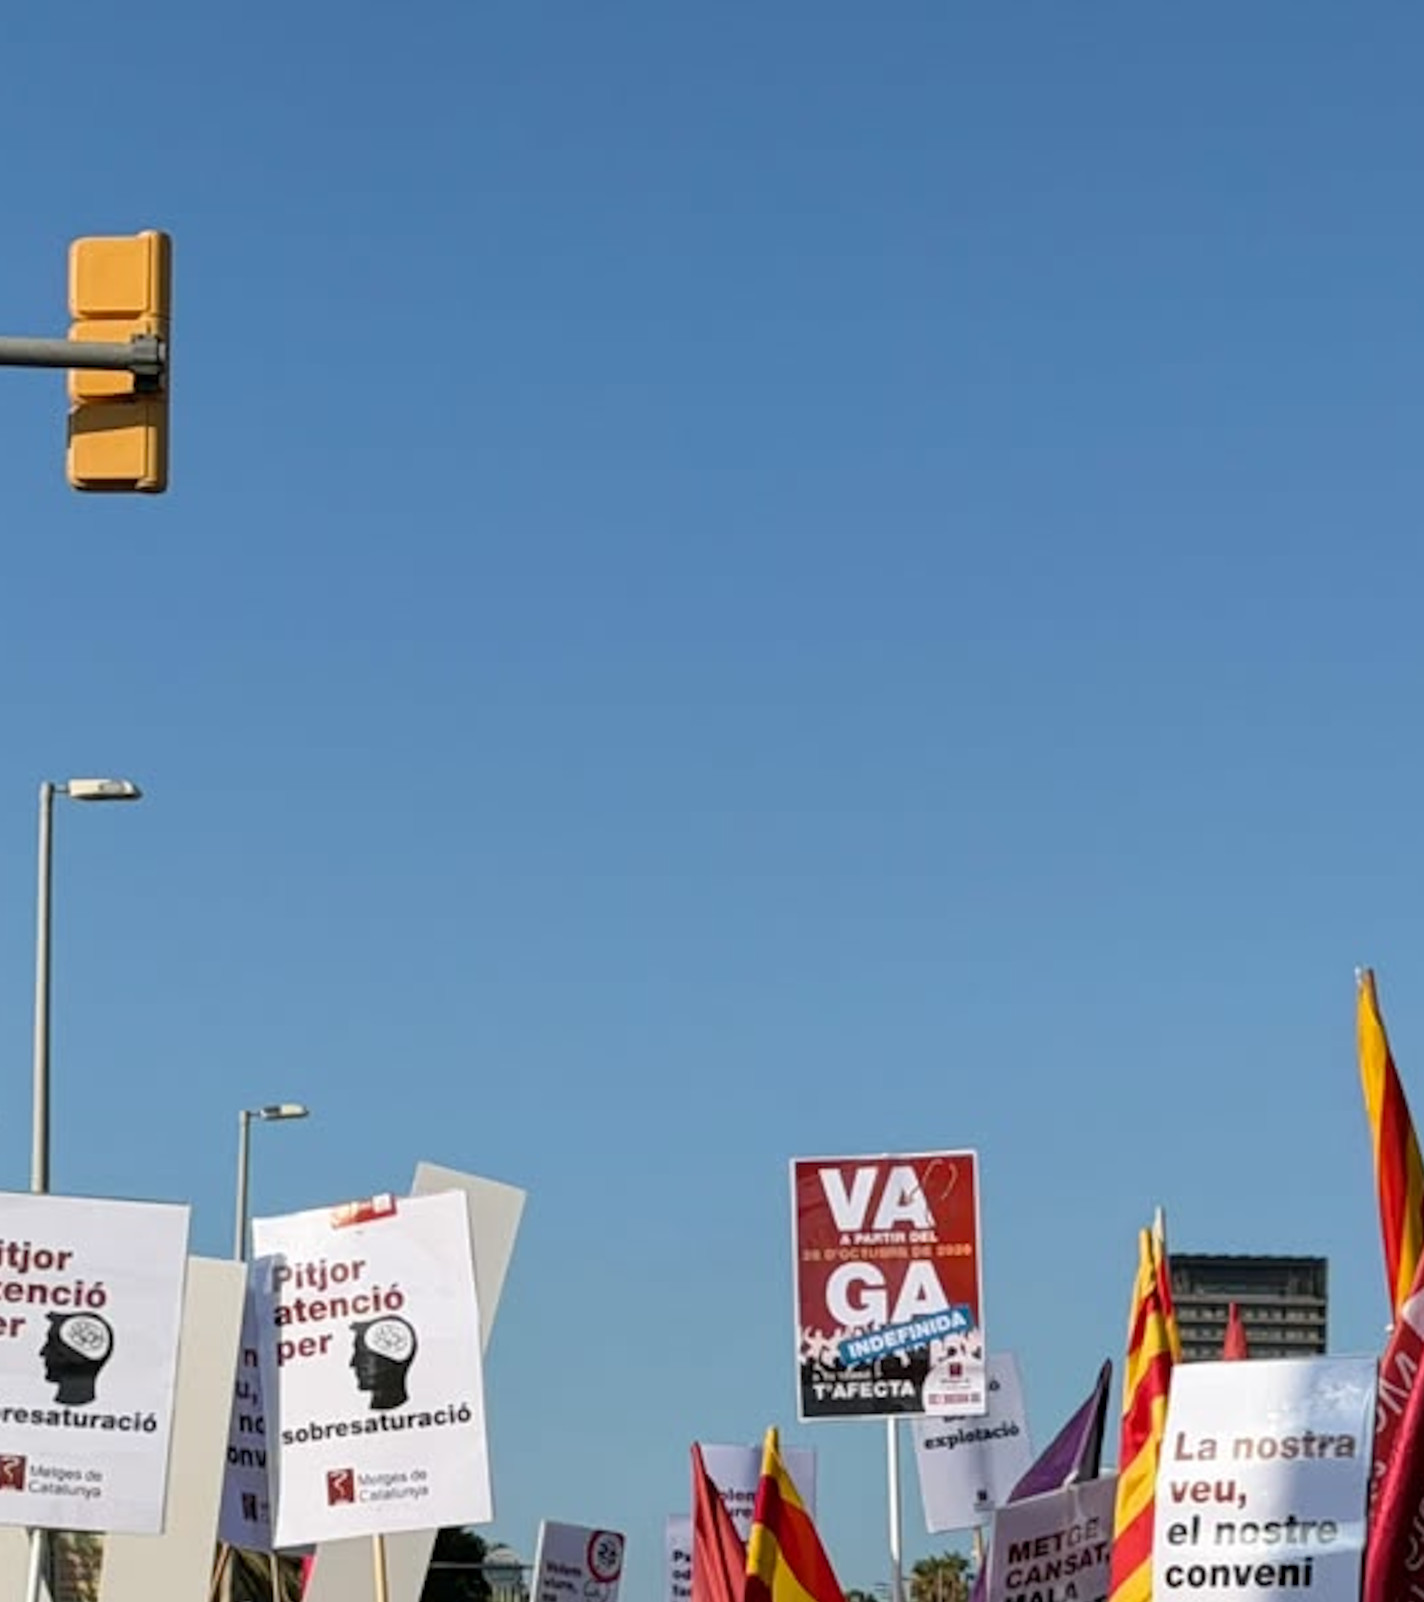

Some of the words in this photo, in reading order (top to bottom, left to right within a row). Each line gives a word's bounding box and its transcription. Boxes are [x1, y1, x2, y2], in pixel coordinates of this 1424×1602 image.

[818, 1165, 935, 1232] VA
[909, 1231, 938, 1244] DEL
[273, 1256, 366, 1294] Pitjor
[274, 1284, 405, 1328] atenció
[827, 1259, 951, 1328] GA
[277, 1331, 333, 1368] per
[846, 1310, 967, 1360] INDEFINIDA
[812, 1380, 916, 1400] T'AFECTA
[282, 1404, 472, 1446] sobresaturació
[1174, 1431, 1217, 1461] La
[1233, 1431, 1356, 1460] nostra
[30, 1465, 82, 1482] Metges
[85, 1470, 103, 1482] de
[411, 1467, 428, 1481] de
[28, 1480, 102, 1499] Catalunya
[359, 1484, 429, 1503] Catalunya
[1170, 1479, 1247, 1509] veu,
[1008, 1516, 1101, 1563] METGE
[1167, 1514, 1201, 1545] el
[1214, 1514, 1338, 1545] nostre
[1165, 1556, 1314, 1588] conveni
